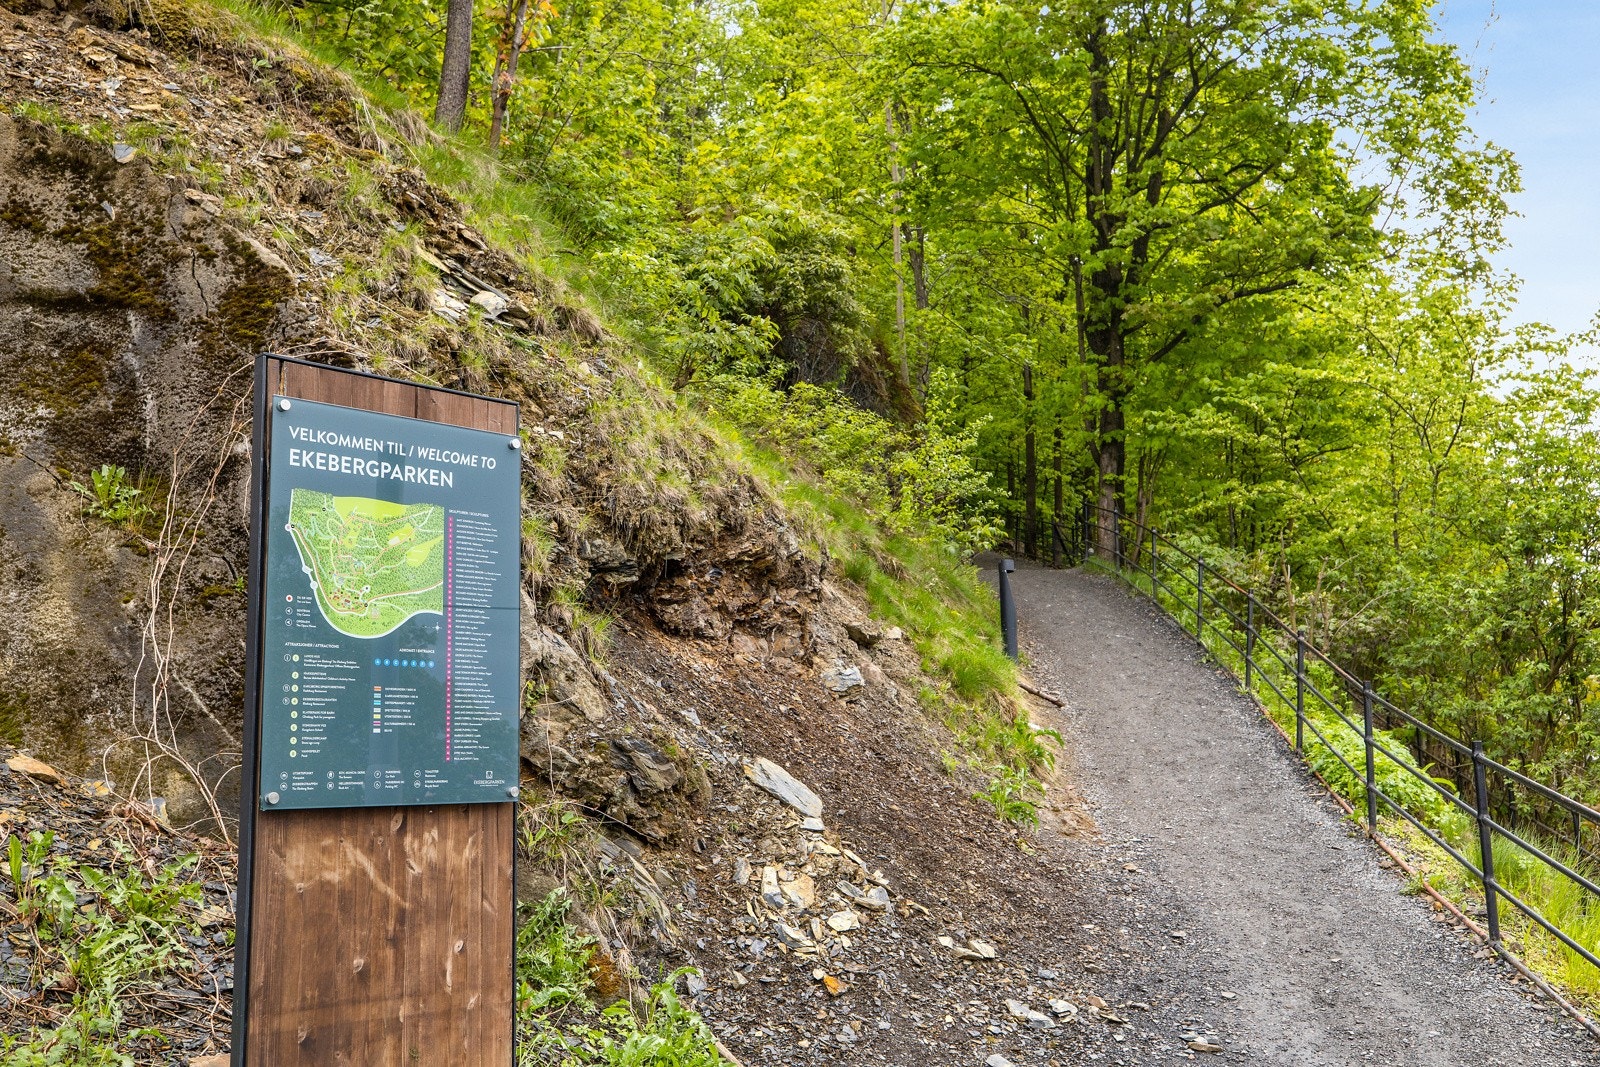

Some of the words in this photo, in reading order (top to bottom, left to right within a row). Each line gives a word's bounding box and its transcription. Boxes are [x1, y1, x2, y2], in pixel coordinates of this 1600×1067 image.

[289, 425, 384, 453] VELKOMMEN
[387, 441, 406, 456] TIL
[408, 445, 414, 457] /
[417, 446, 477, 467] WELCOME
[480, 456, 497, 470] TO
[289, 448, 454, 489] EKEBERGPARKEN
